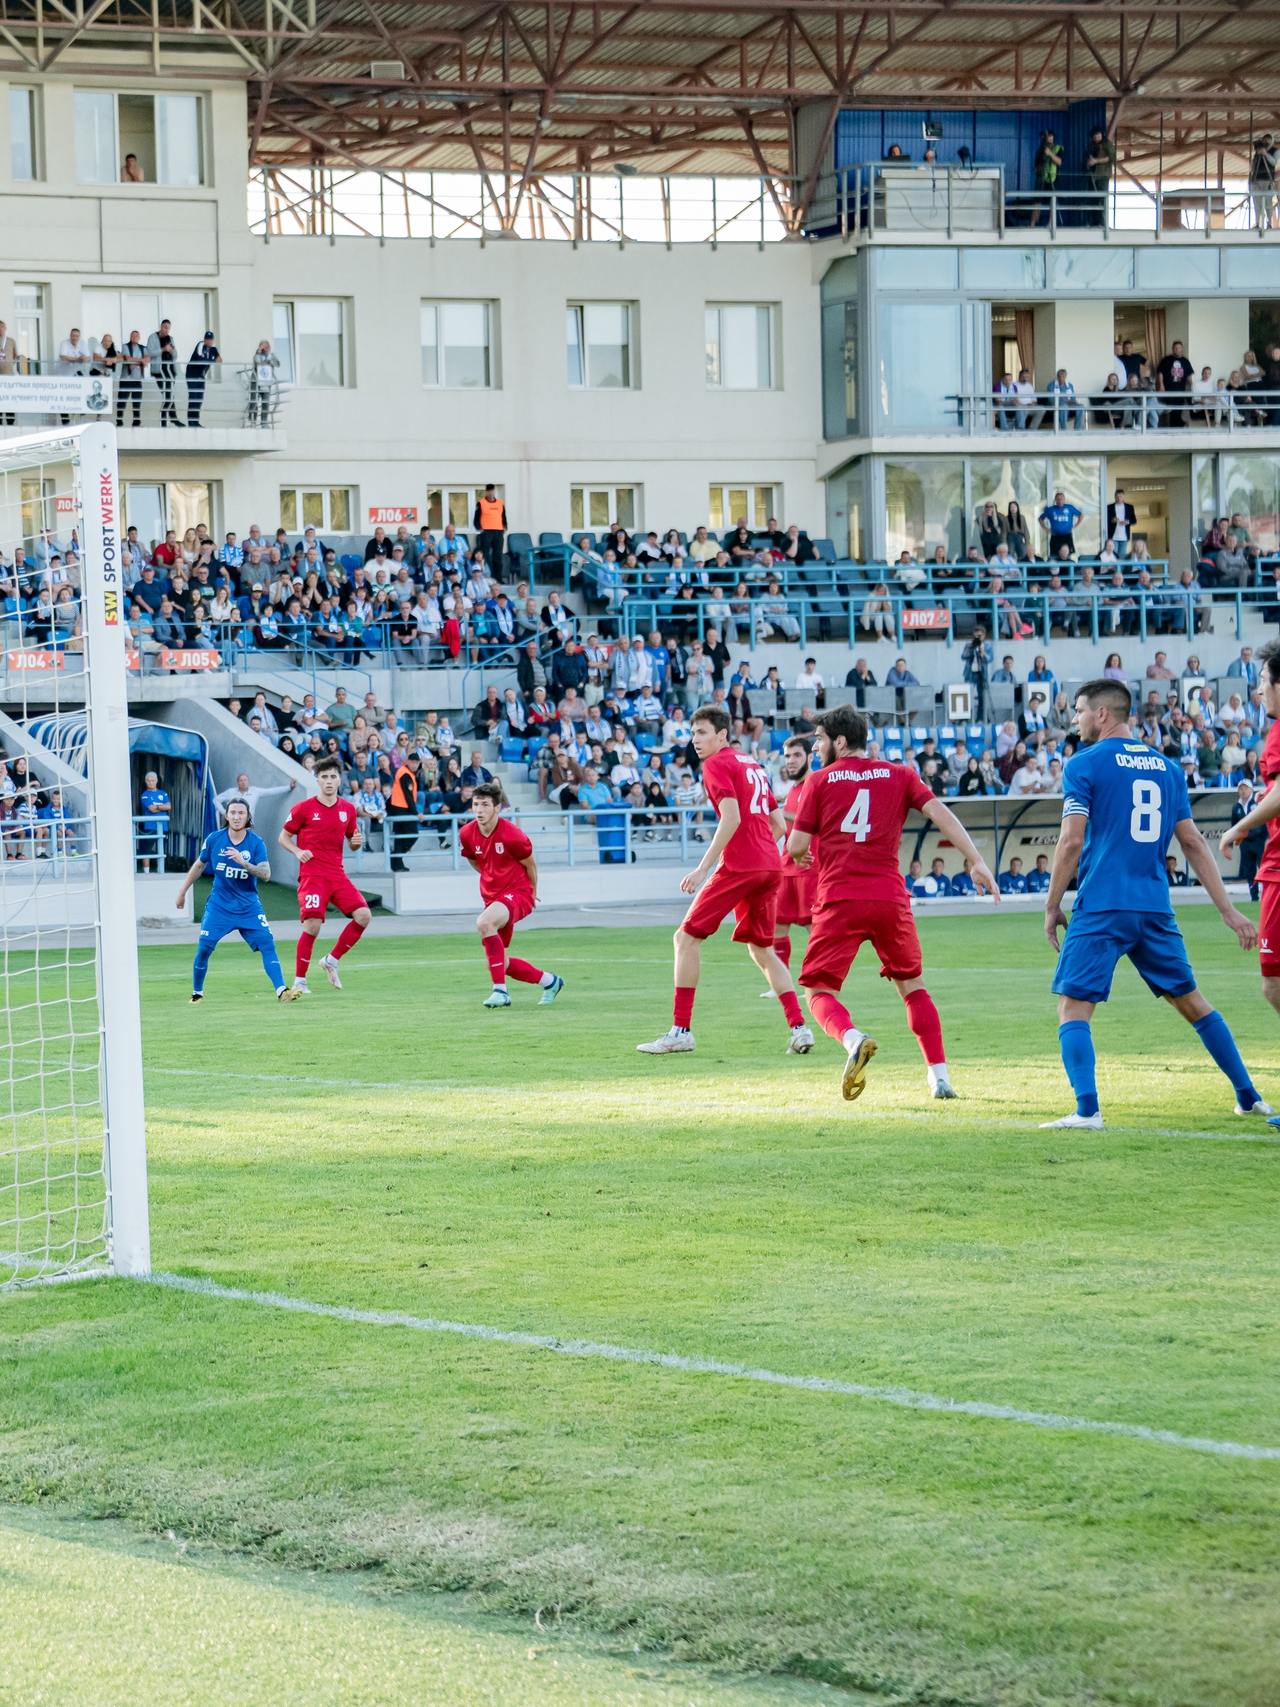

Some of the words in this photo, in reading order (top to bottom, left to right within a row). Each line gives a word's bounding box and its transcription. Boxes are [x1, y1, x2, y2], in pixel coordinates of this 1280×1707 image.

[32, 382, 58, 391] природа
[39, 395, 59, 404] порта
[66, 396, 82, 404] мире
[100, 473, 116, 583] SPORTWERK
[104, 591, 118, 623] SW
[1115, 753, 1167, 772] ОСМАНОВ
[840, 788, 871, 843] 4
[1130, 779, 1162, 843] 8
[225, 866, 249, 880] ВТБ
[305, 894, 320, 909] 29
